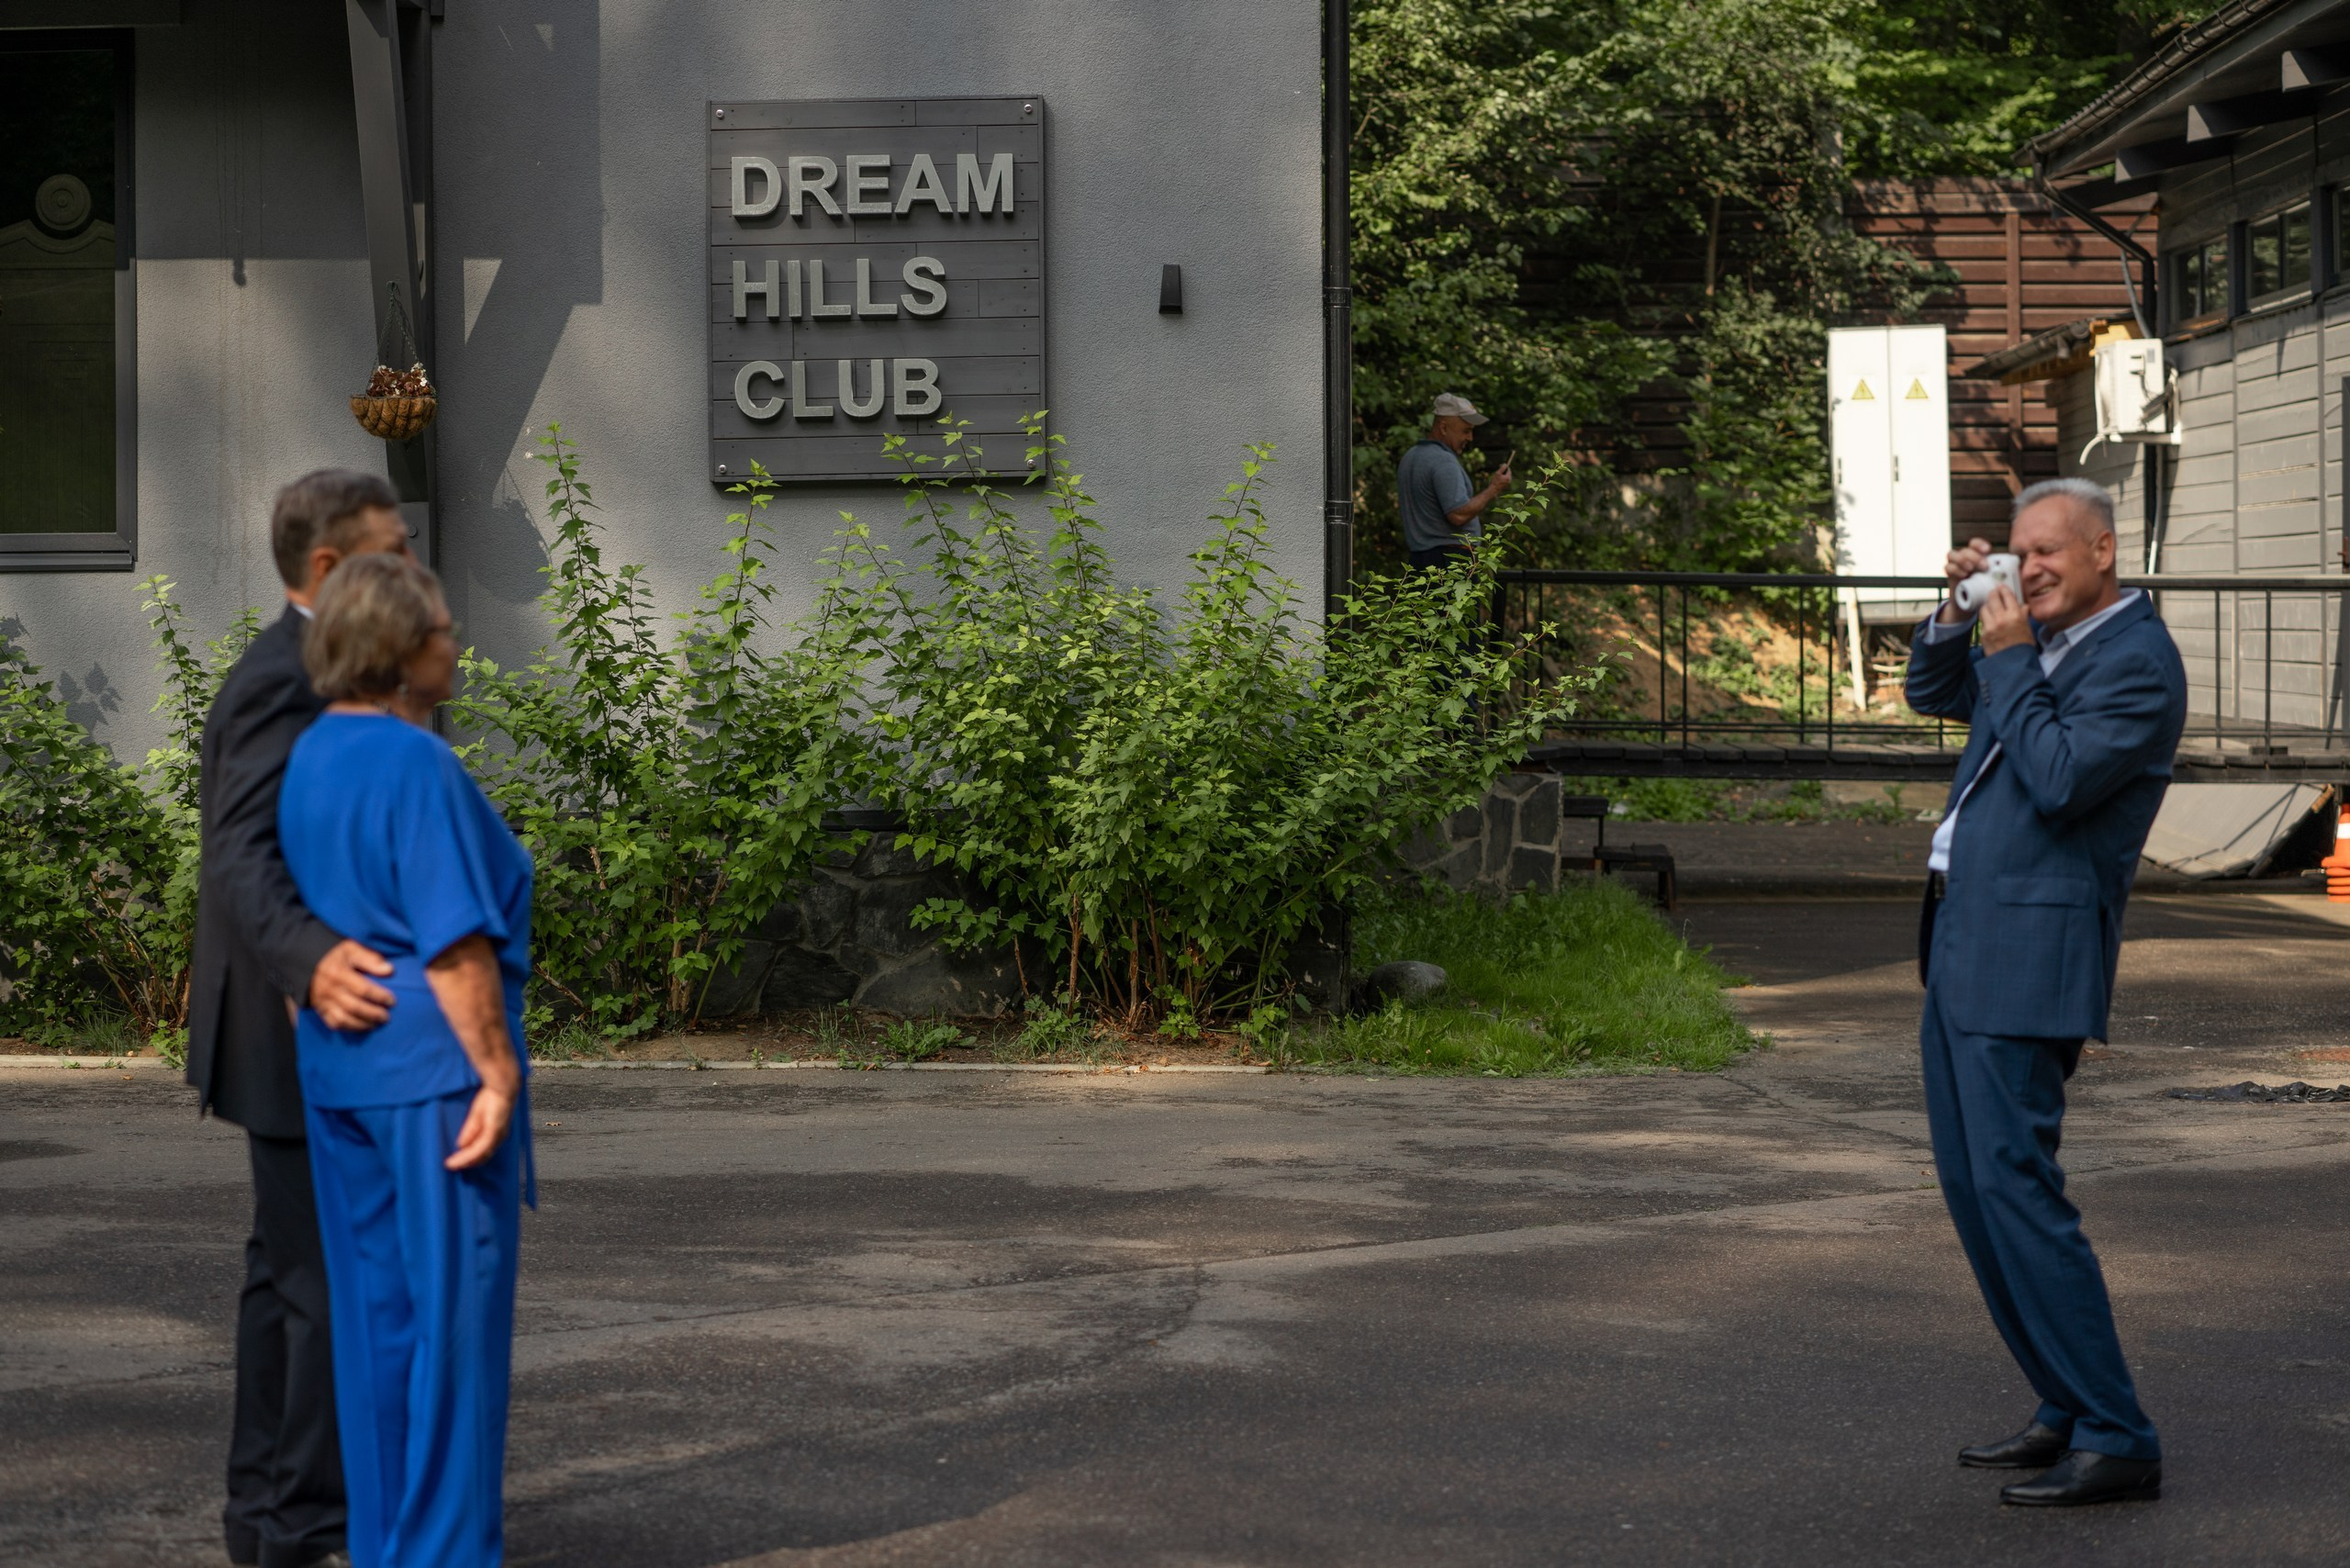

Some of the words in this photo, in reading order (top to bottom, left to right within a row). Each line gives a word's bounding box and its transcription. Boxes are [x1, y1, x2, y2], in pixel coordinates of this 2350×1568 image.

[732, 153, 1014, 217] DREAM
[733, 256, 947, 318] HILLS
[734, 358, 942, 420] CLUB
